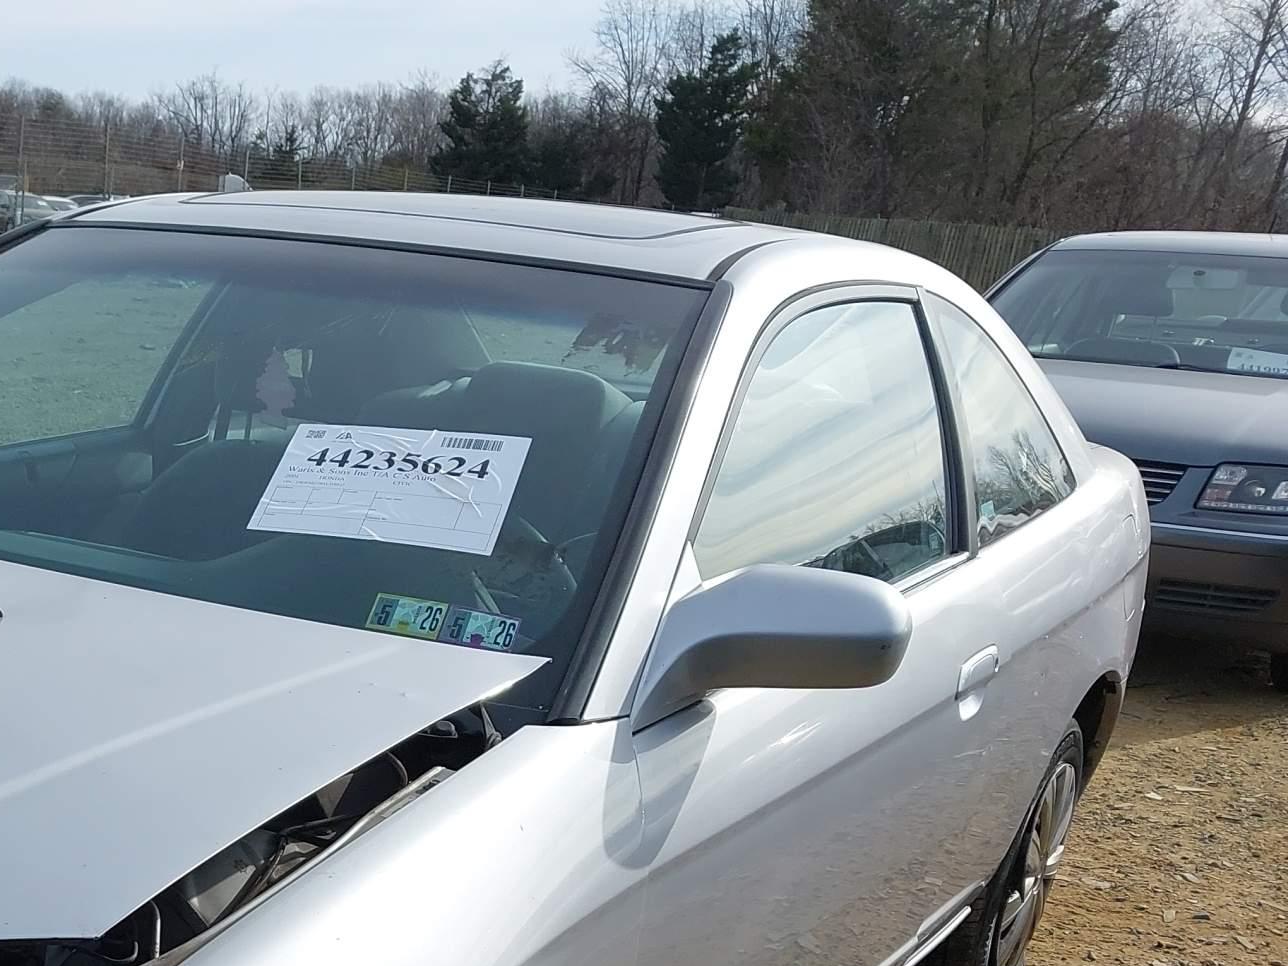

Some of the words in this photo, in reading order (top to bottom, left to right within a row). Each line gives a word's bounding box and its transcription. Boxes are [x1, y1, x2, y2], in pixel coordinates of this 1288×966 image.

[307, 448, 491, 479] 44235624
[328, 468, 351, 476] Sons
[372, 470, 390, 478] T/A
[412, 474, 437, 482] Auto
[377, 604, 393, 626] 5
[419, 605, 443, 632] 26
[449, 616, 465, 639] 5
[493, 620, 517, 648] 26
